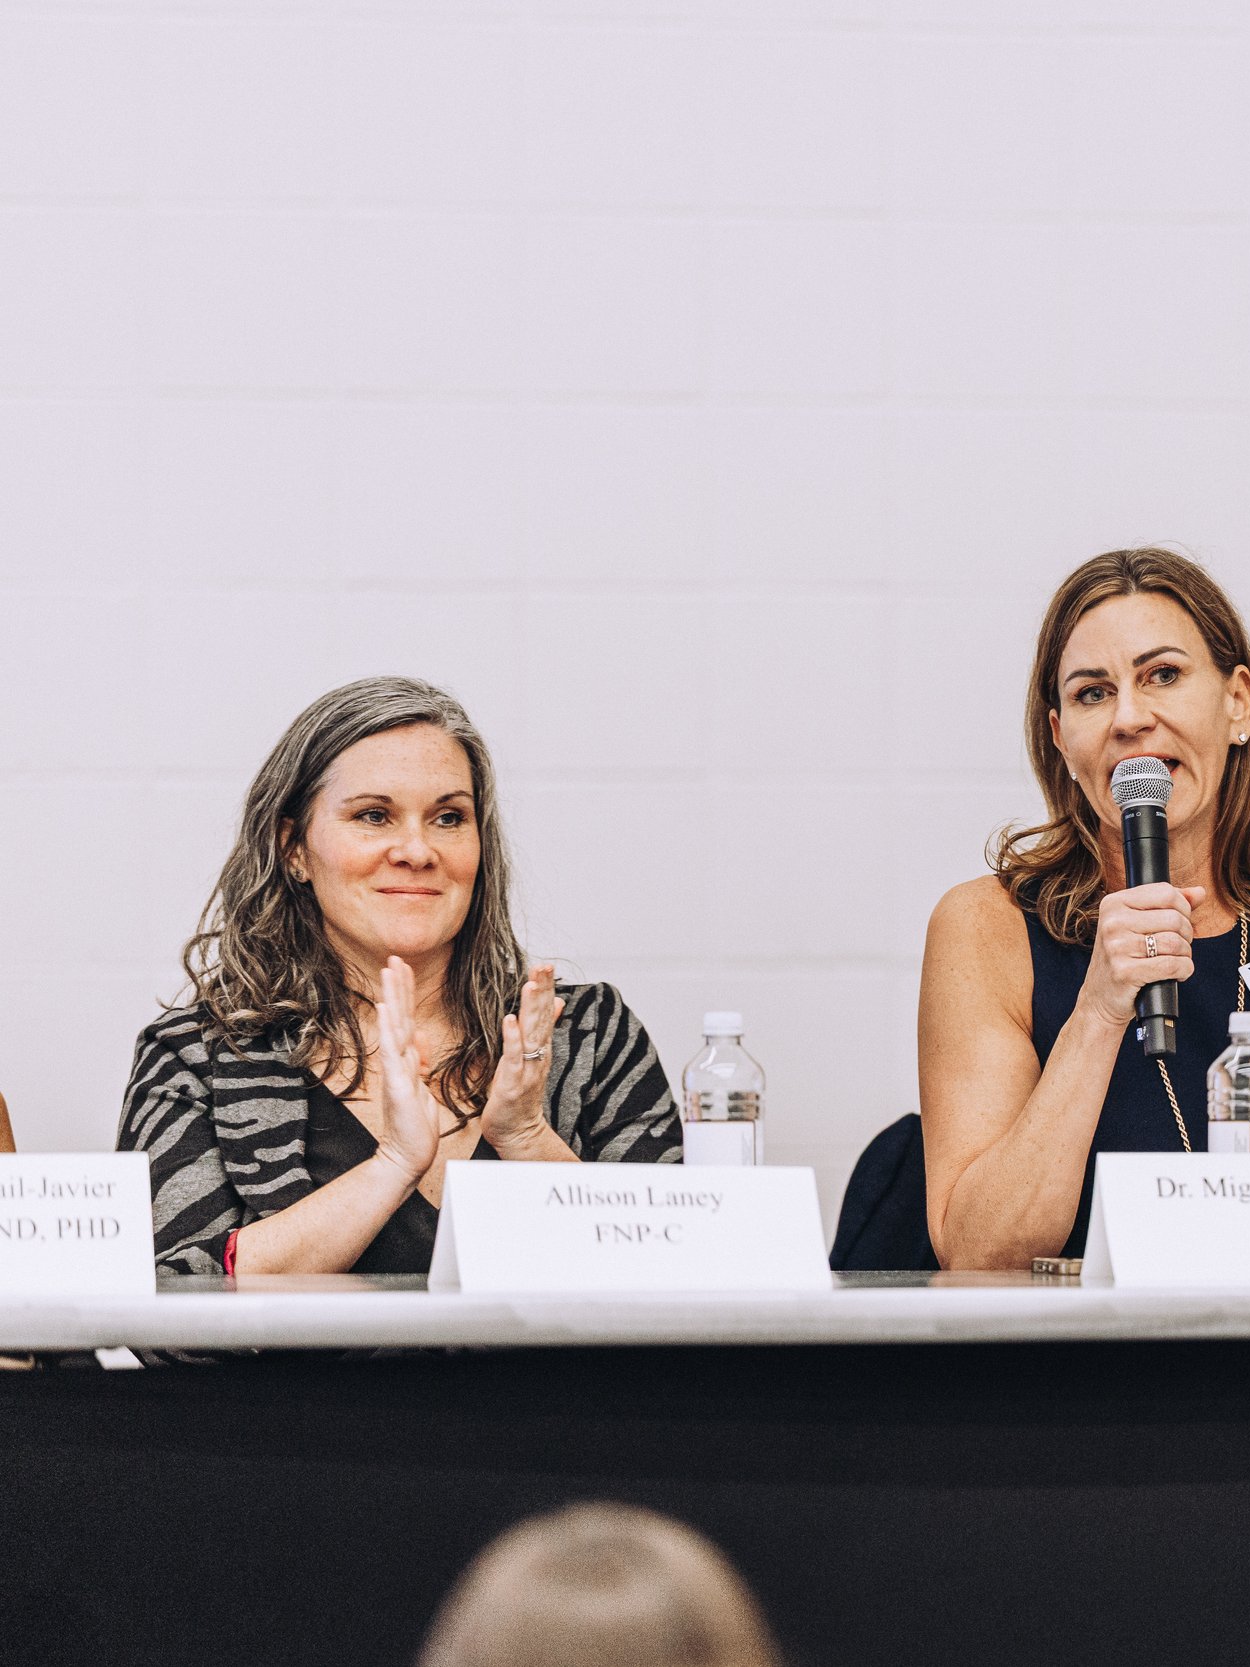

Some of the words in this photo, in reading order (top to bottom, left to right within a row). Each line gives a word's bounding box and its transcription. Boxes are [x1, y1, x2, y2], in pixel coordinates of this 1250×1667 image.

[546, 1184, 637, 1207] Allison
[646, 1185, 723, 1214] Laney
[1156, 1176, 1193, 1199] Dr.
[57, 1217, 121, 1240] PHD
[594, 1223, 684, 1244] FNP-C
